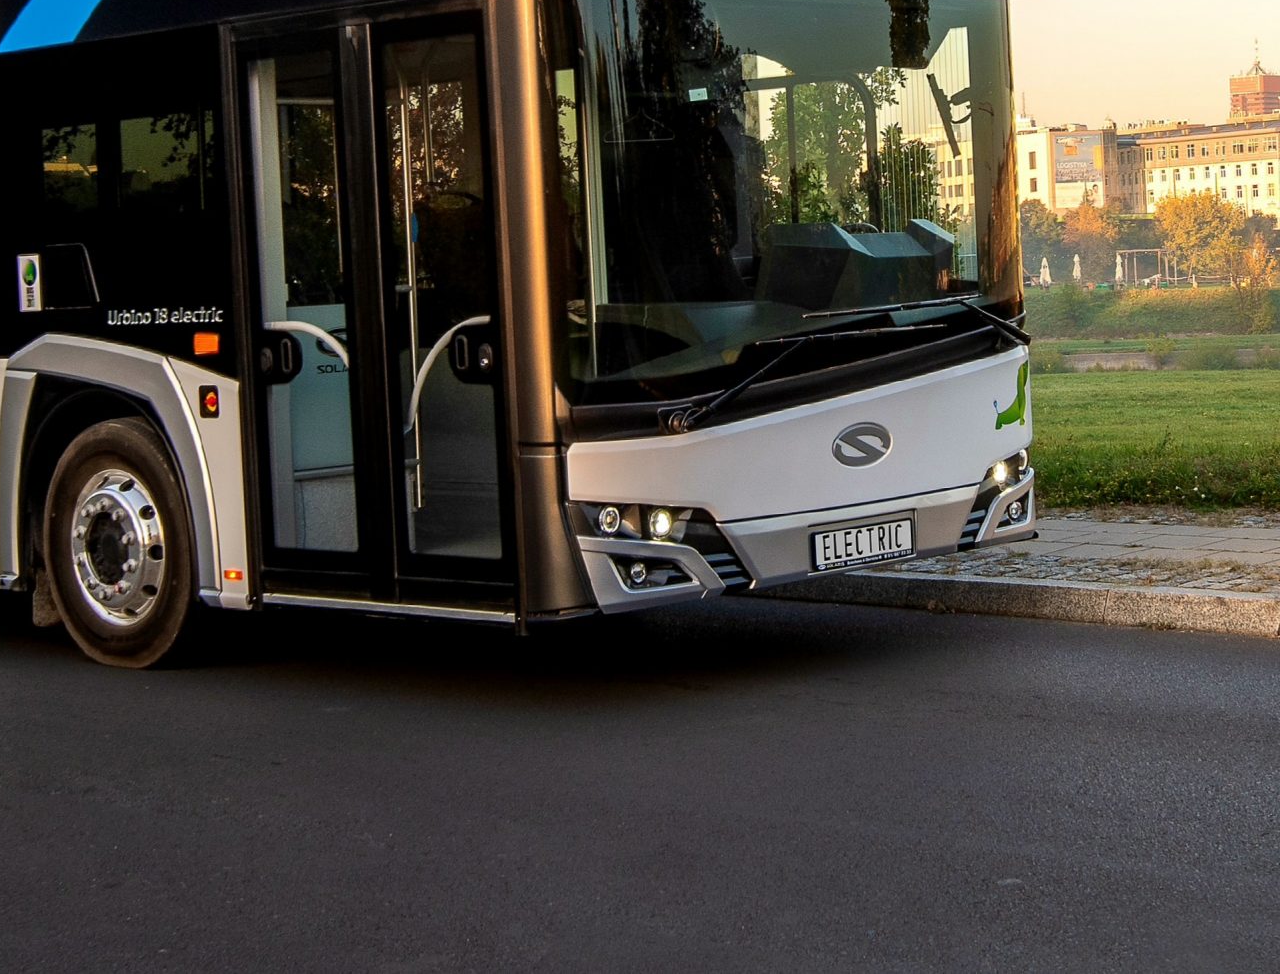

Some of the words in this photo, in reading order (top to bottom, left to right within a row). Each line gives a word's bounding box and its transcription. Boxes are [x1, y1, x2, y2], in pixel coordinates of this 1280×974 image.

[107, 309, 152, 326] Urbino
[153, 307, 169, 324] 18
[170, 305, 224, 324] electric
[822, 523, 903, 561] ELECTRIC
